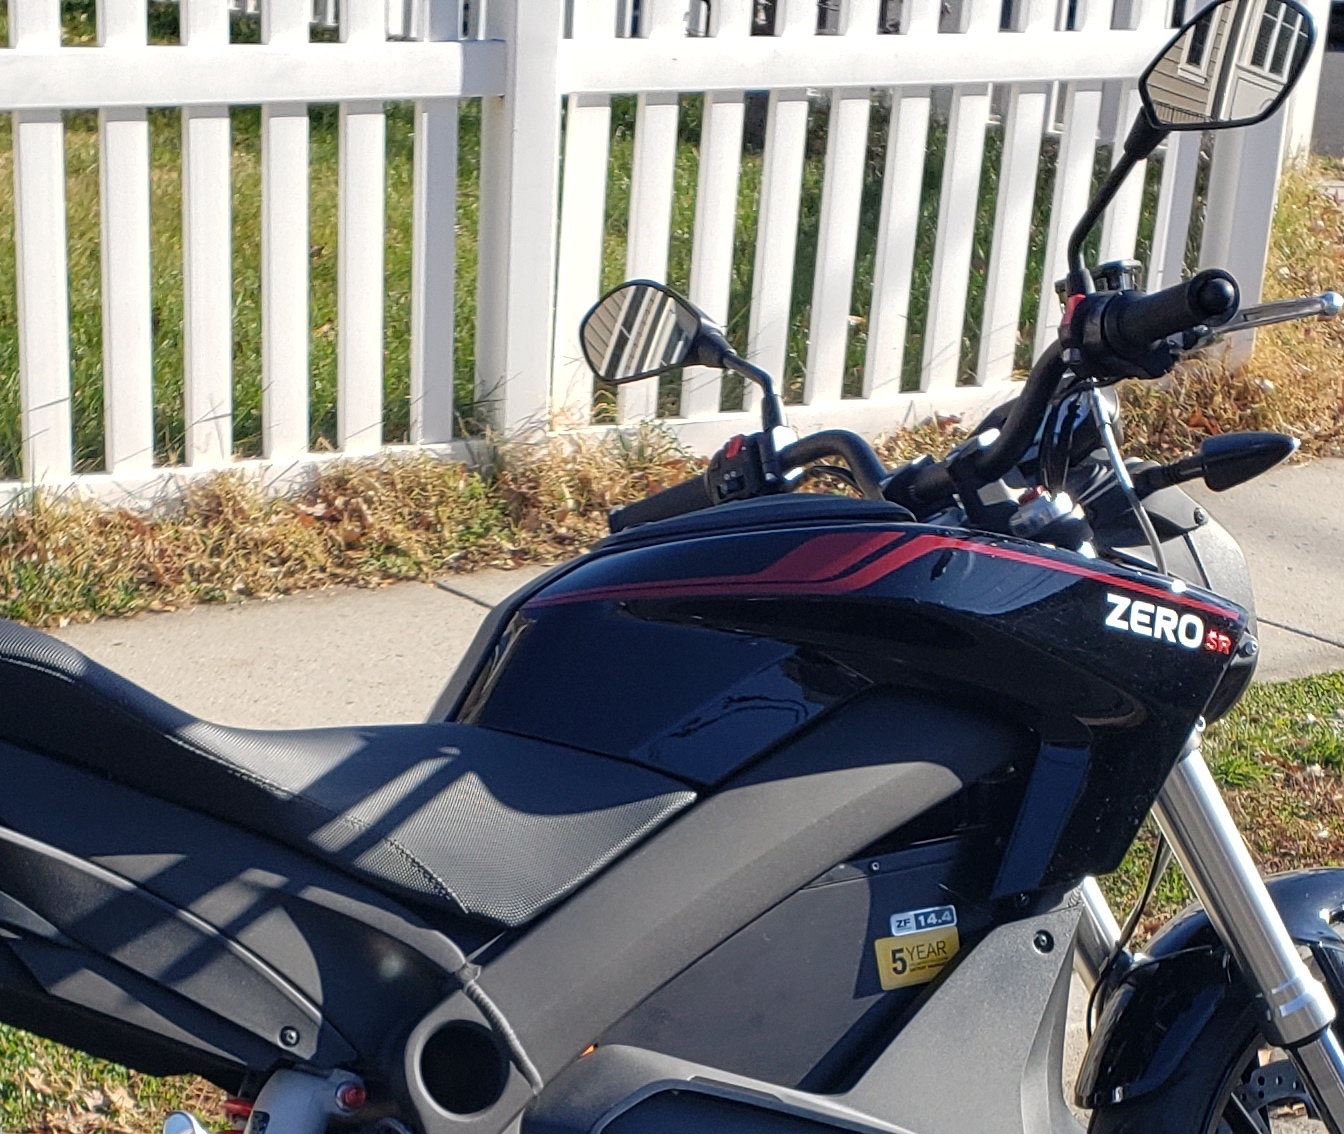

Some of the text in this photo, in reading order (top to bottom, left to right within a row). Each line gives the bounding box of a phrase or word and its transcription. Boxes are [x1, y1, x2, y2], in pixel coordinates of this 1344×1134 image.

[1105, 593, 1232, 655] ZERO SR
[895, 910, 952, 929] ZF 14.4
[891, 947, 907, 975] 5
[906, 941, 947, 961] YEAR
